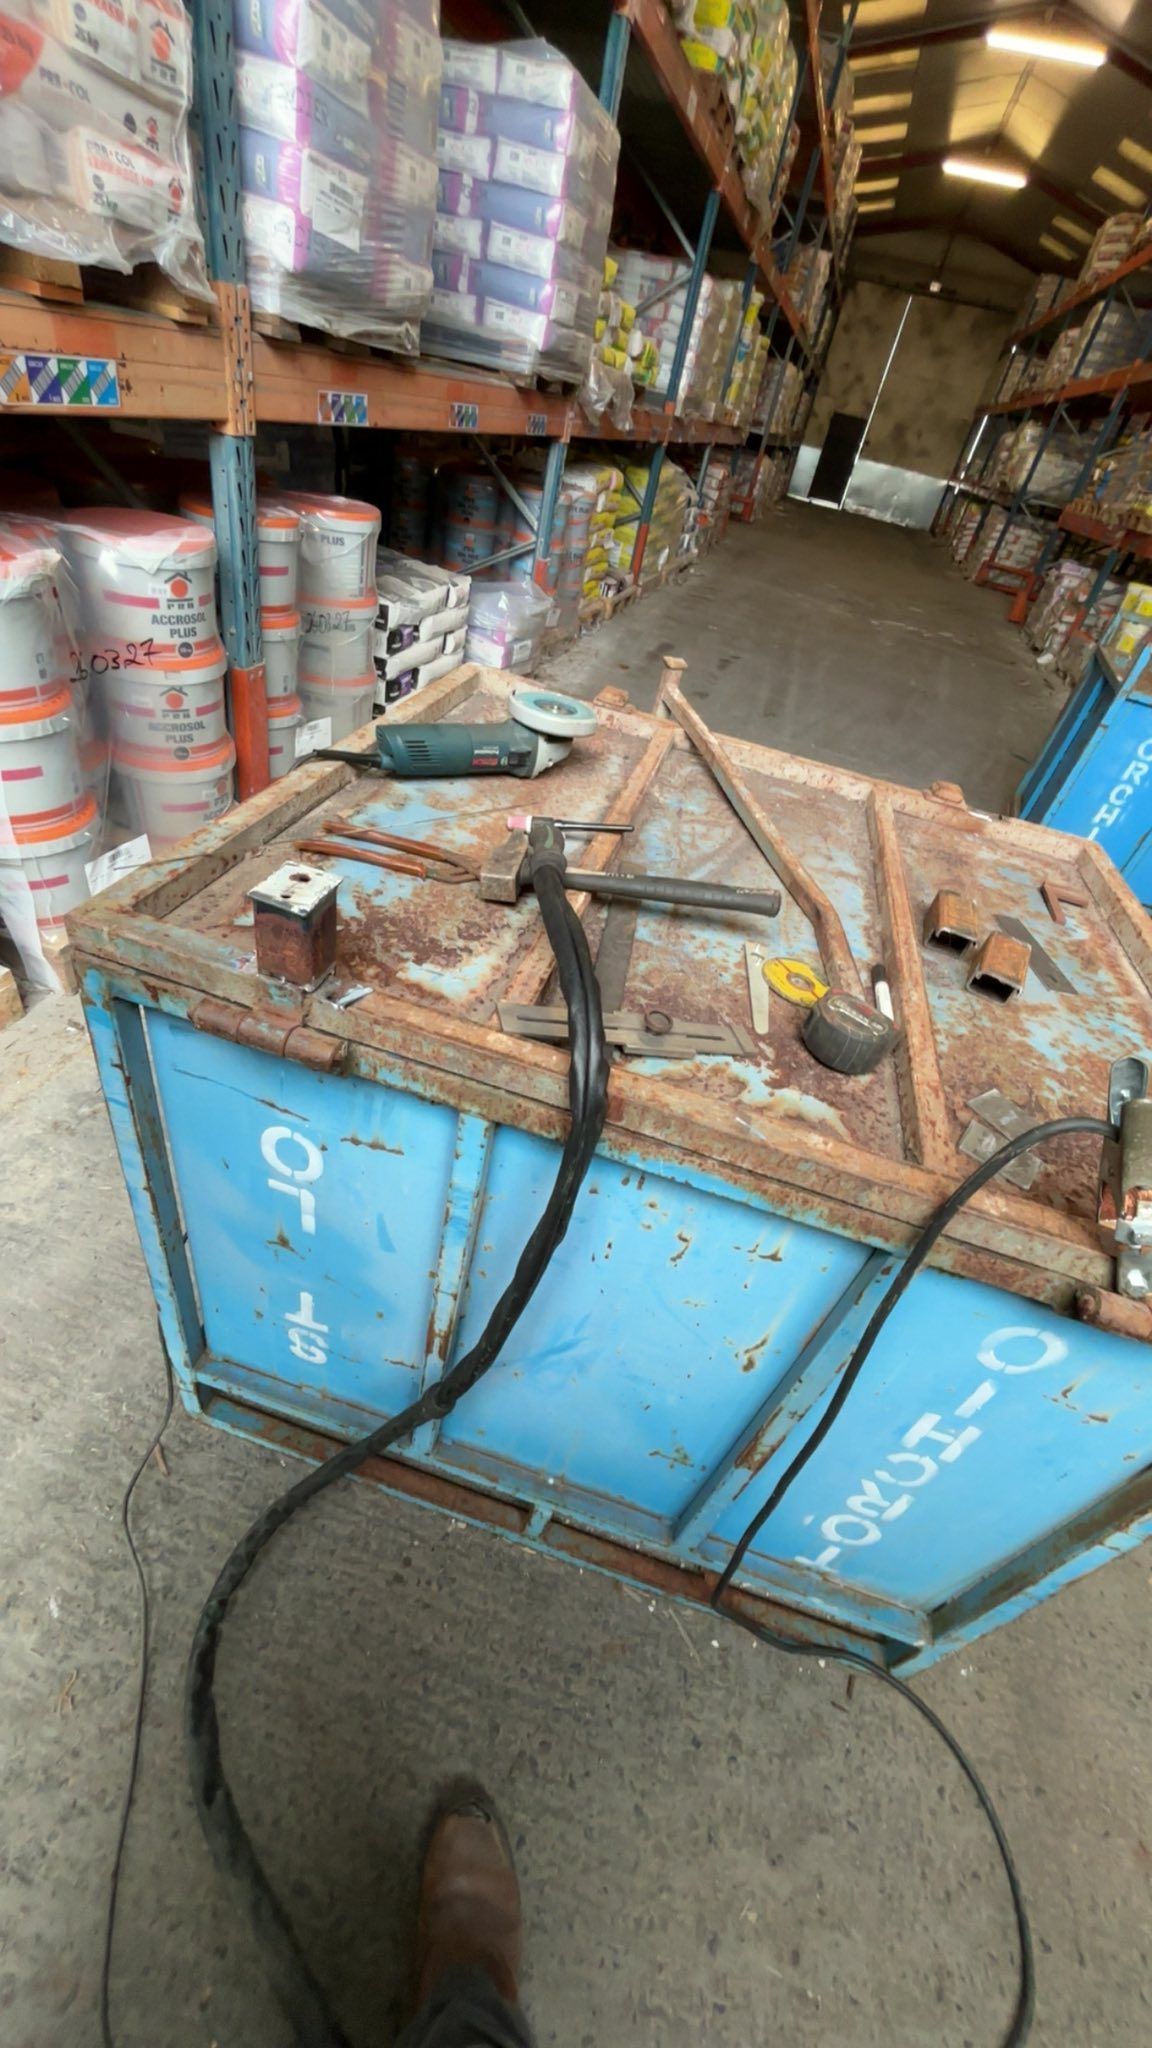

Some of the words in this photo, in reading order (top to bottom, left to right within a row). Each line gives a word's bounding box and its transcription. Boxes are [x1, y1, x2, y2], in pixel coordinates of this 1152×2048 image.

[320, 534, 345, 546] PLUS
[151, 612, 207, 625] ACCROSOL
[169, 626, 197, 639] PLUS
[148, 720, 206, 732] ACCROSOL
[165, 733, 194, 744] PLUS
[794, 1325, 1069, 1574] TORCHIO
